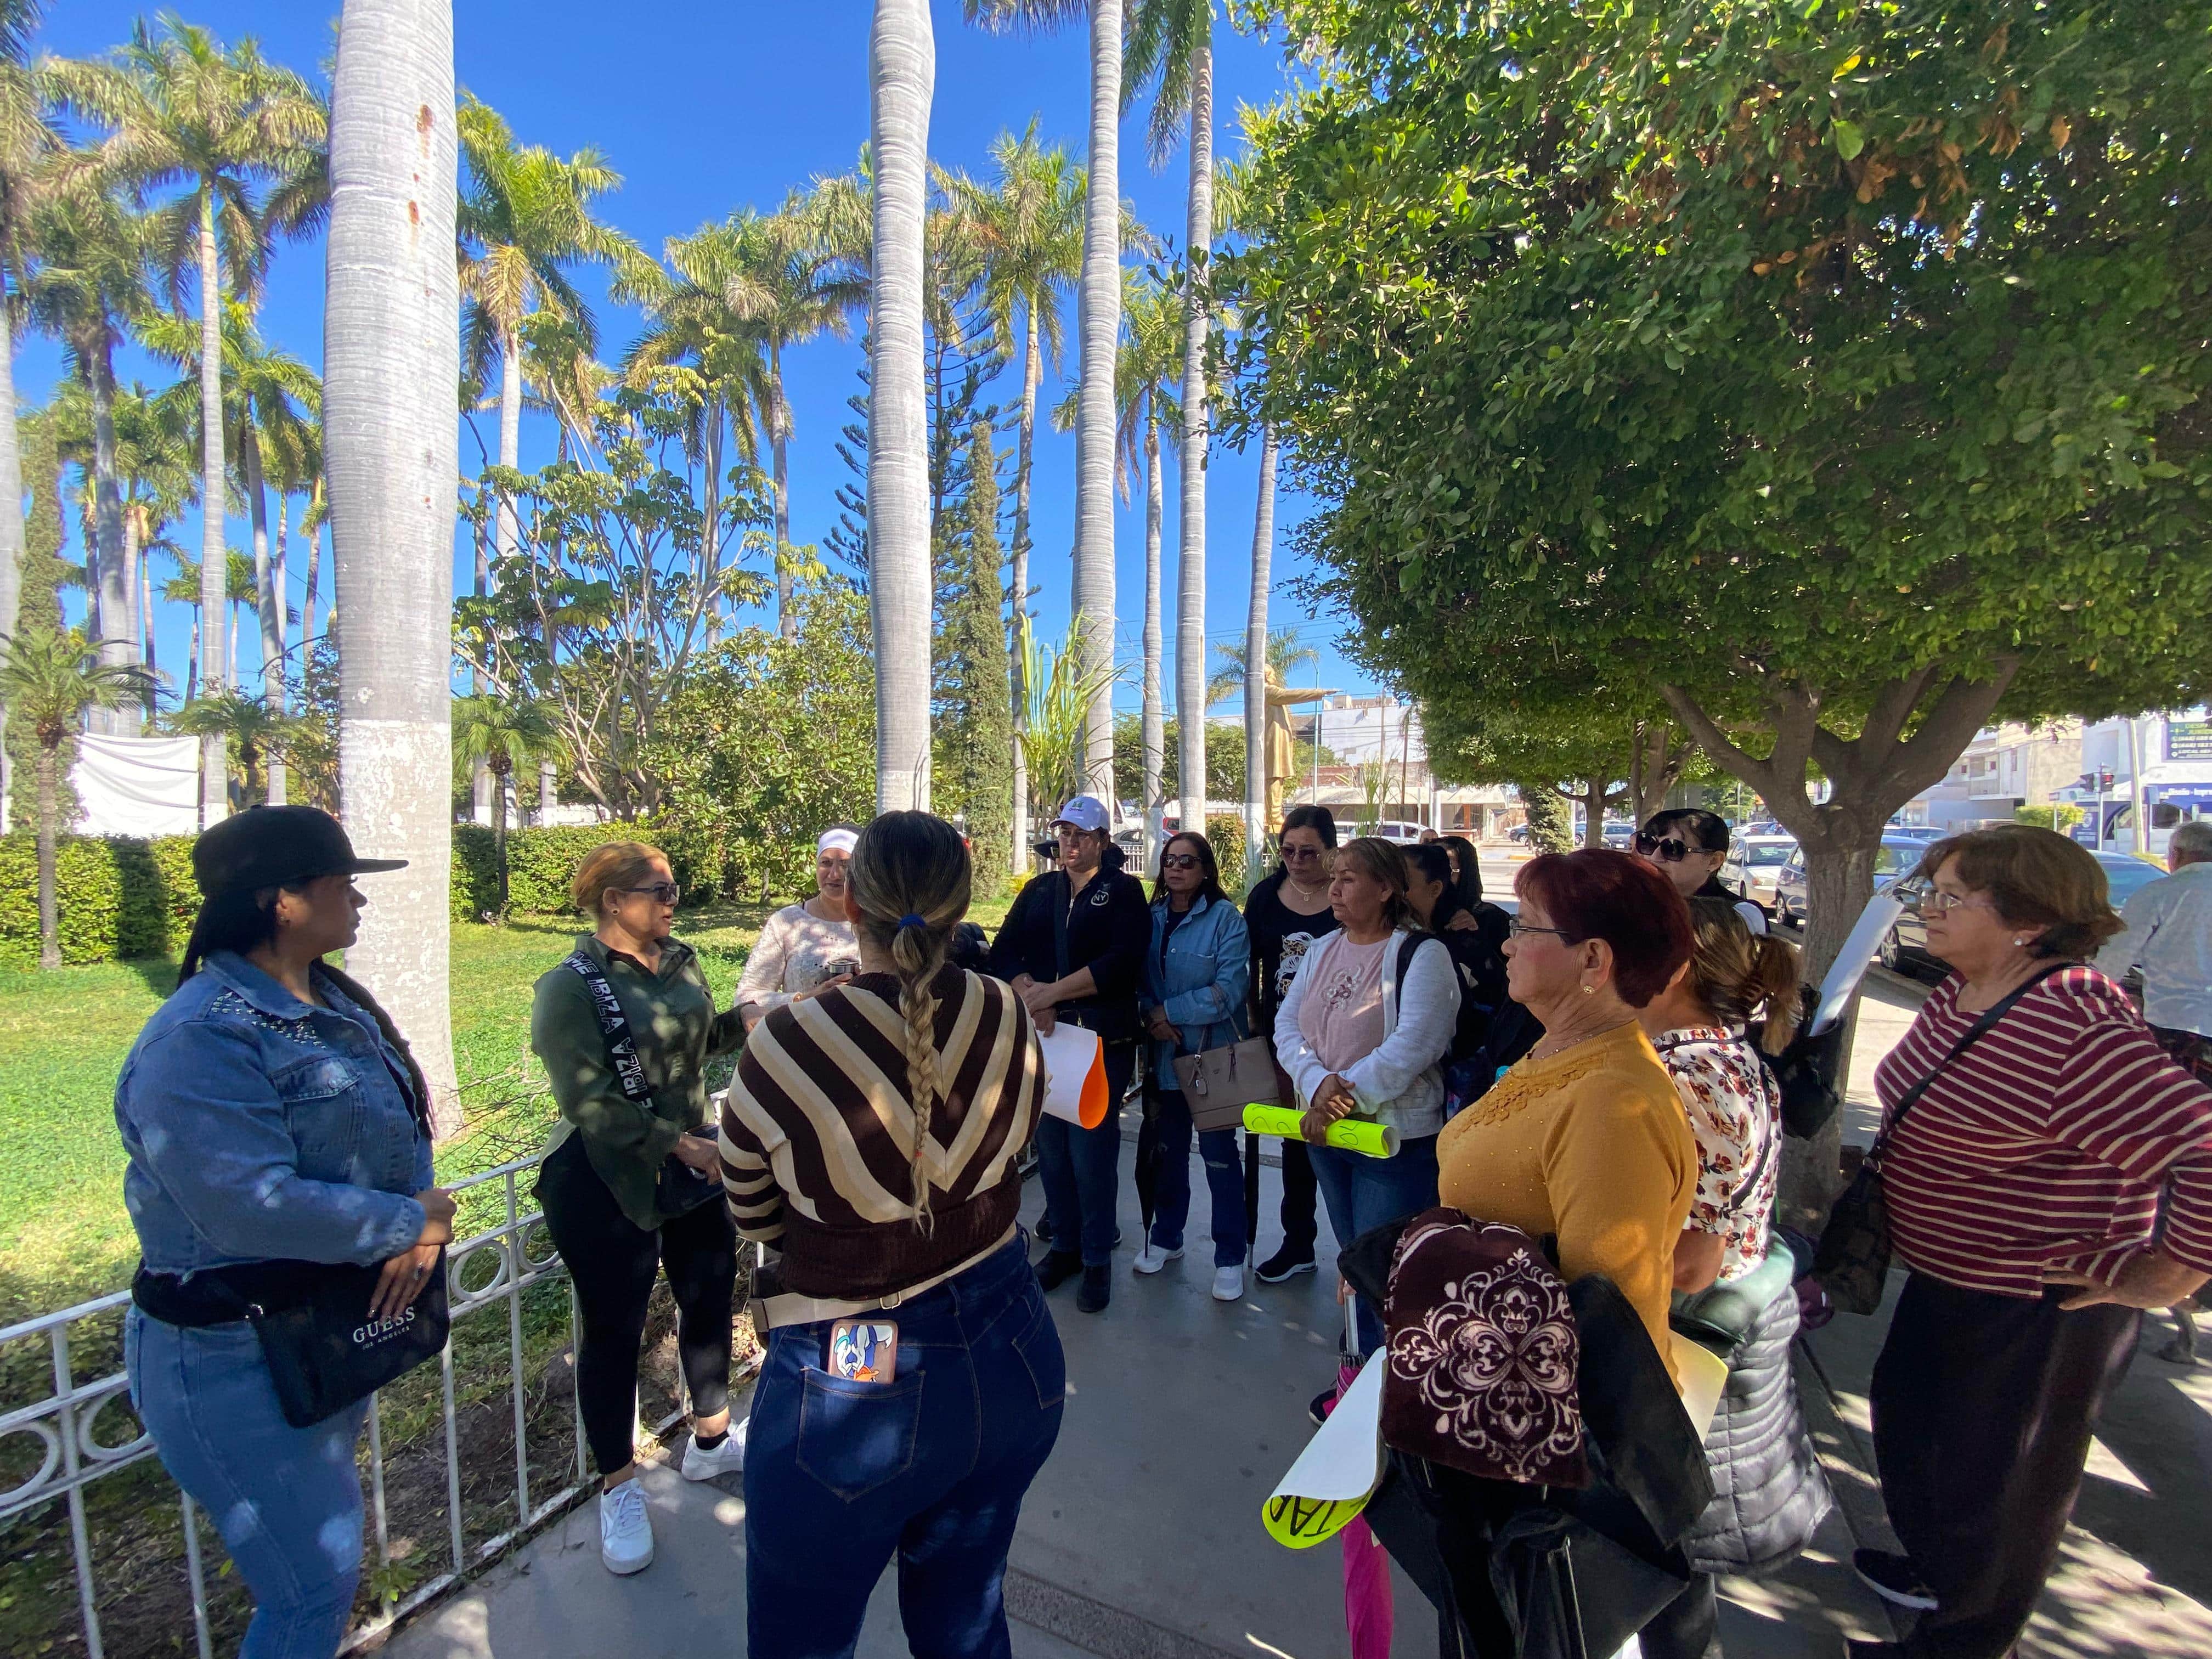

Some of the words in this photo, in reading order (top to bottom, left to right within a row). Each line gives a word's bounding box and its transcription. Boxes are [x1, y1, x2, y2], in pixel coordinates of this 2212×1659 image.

[587, 978, 624, 1034] IBIZA
[612, 1036, 647, 1095] IBIZA
[353, 1306, 415, 1342] GUESS
